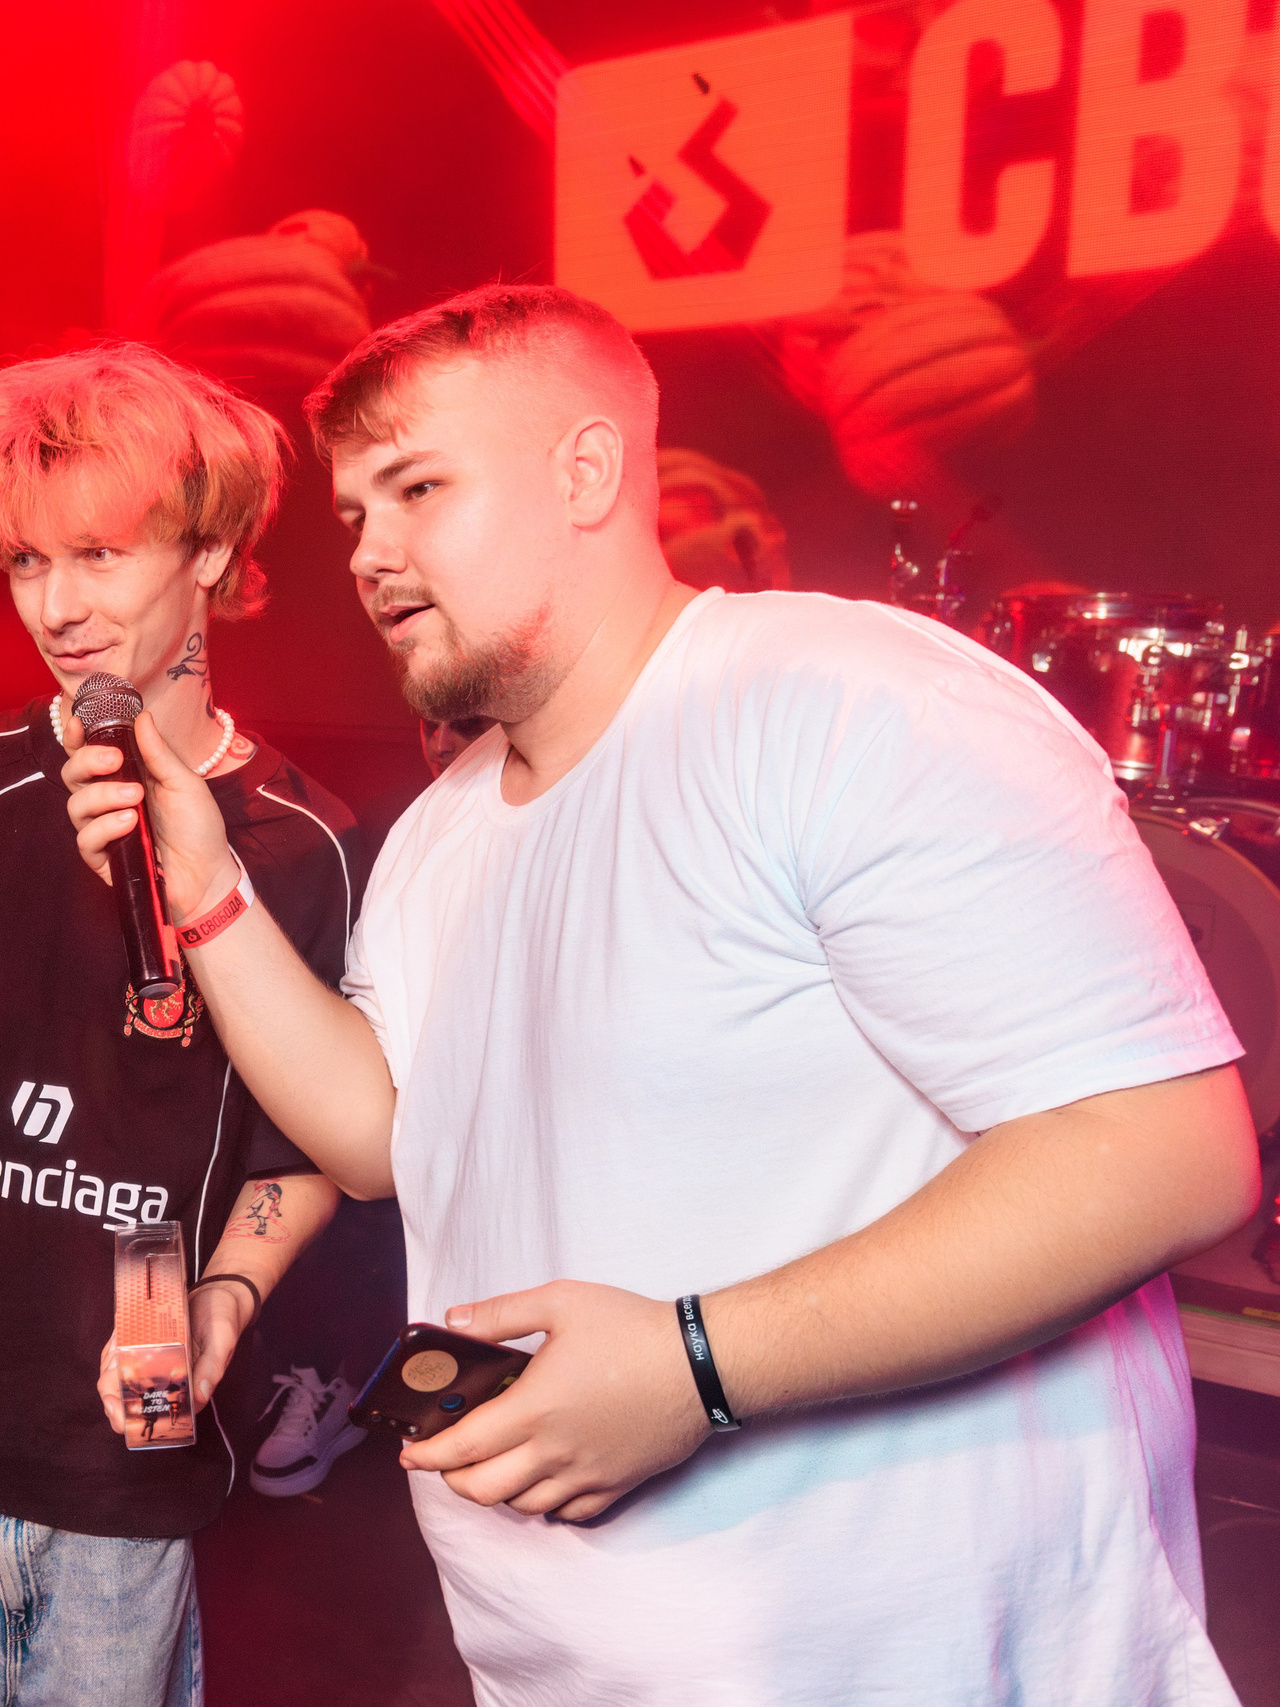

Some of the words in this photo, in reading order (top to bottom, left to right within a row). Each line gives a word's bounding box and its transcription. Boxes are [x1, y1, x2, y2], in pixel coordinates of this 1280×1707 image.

[901, 0, 1280, 292] СВ
[200, 896, 243, 936] СВОБОДА
[683, 1295, 694, 1321] всегд
[687, 1322, 705, 1361] наука
[143, 1390, 169, 1400] DARE
